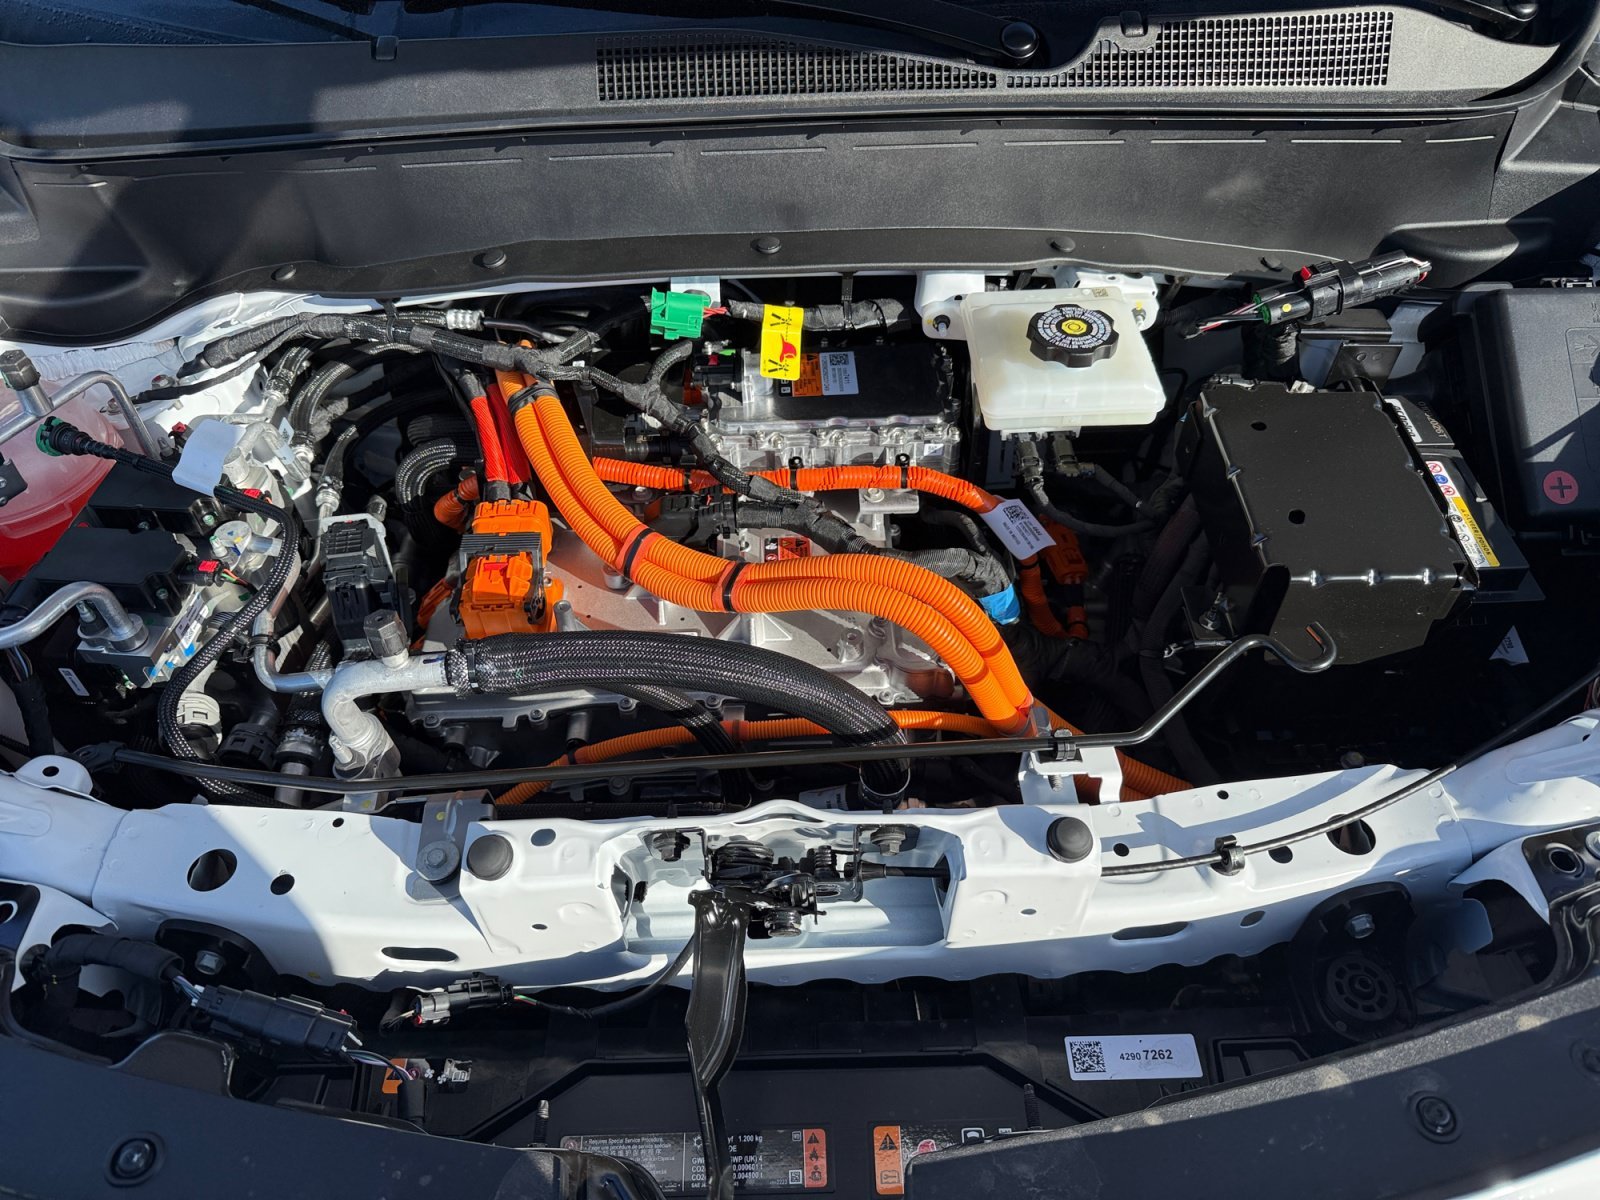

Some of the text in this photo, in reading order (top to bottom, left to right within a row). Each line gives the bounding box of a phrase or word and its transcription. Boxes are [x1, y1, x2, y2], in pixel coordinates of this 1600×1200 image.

[1120, 1049, 1173, 1061] 4290 7262
[738, 1135, 754, 1143] 1.200
[754, 1134, 763, 1144] kg
[731, 1155, 743, 1163] WP
[743, 1155, 758, 1164] (UK)
